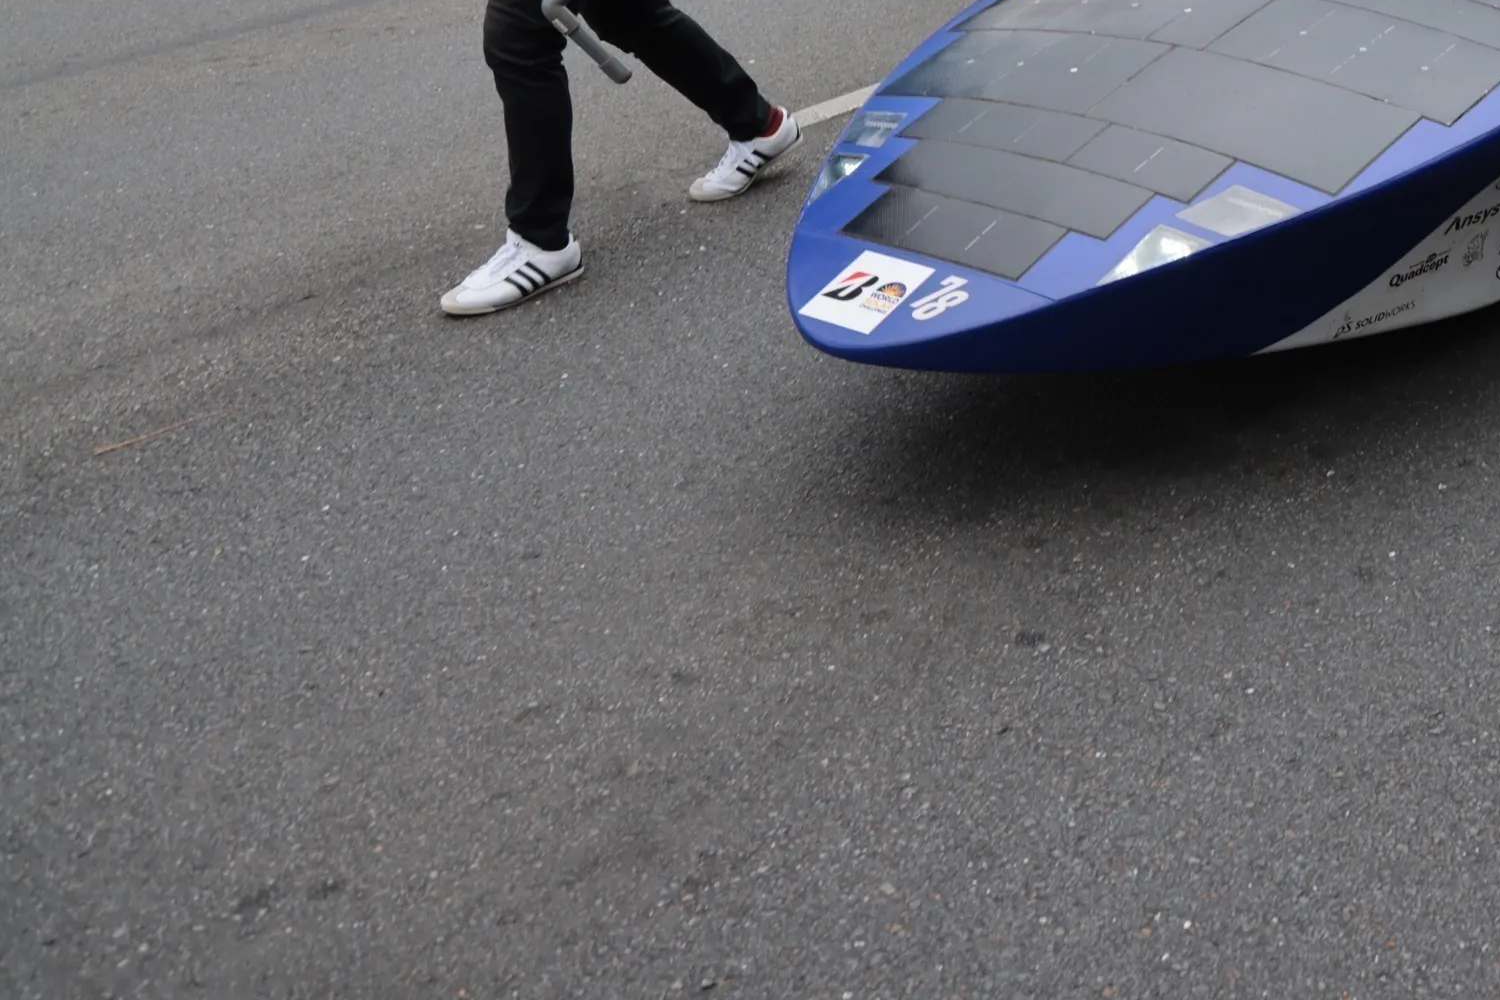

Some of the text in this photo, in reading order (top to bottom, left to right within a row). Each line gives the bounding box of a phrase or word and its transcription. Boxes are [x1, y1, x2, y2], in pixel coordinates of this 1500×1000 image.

[1389, 254, 1450, 288] Quadcept
[909, 275, 969, 320] 78
[1355, 300, 1416, 330] SOLIDWORKS
